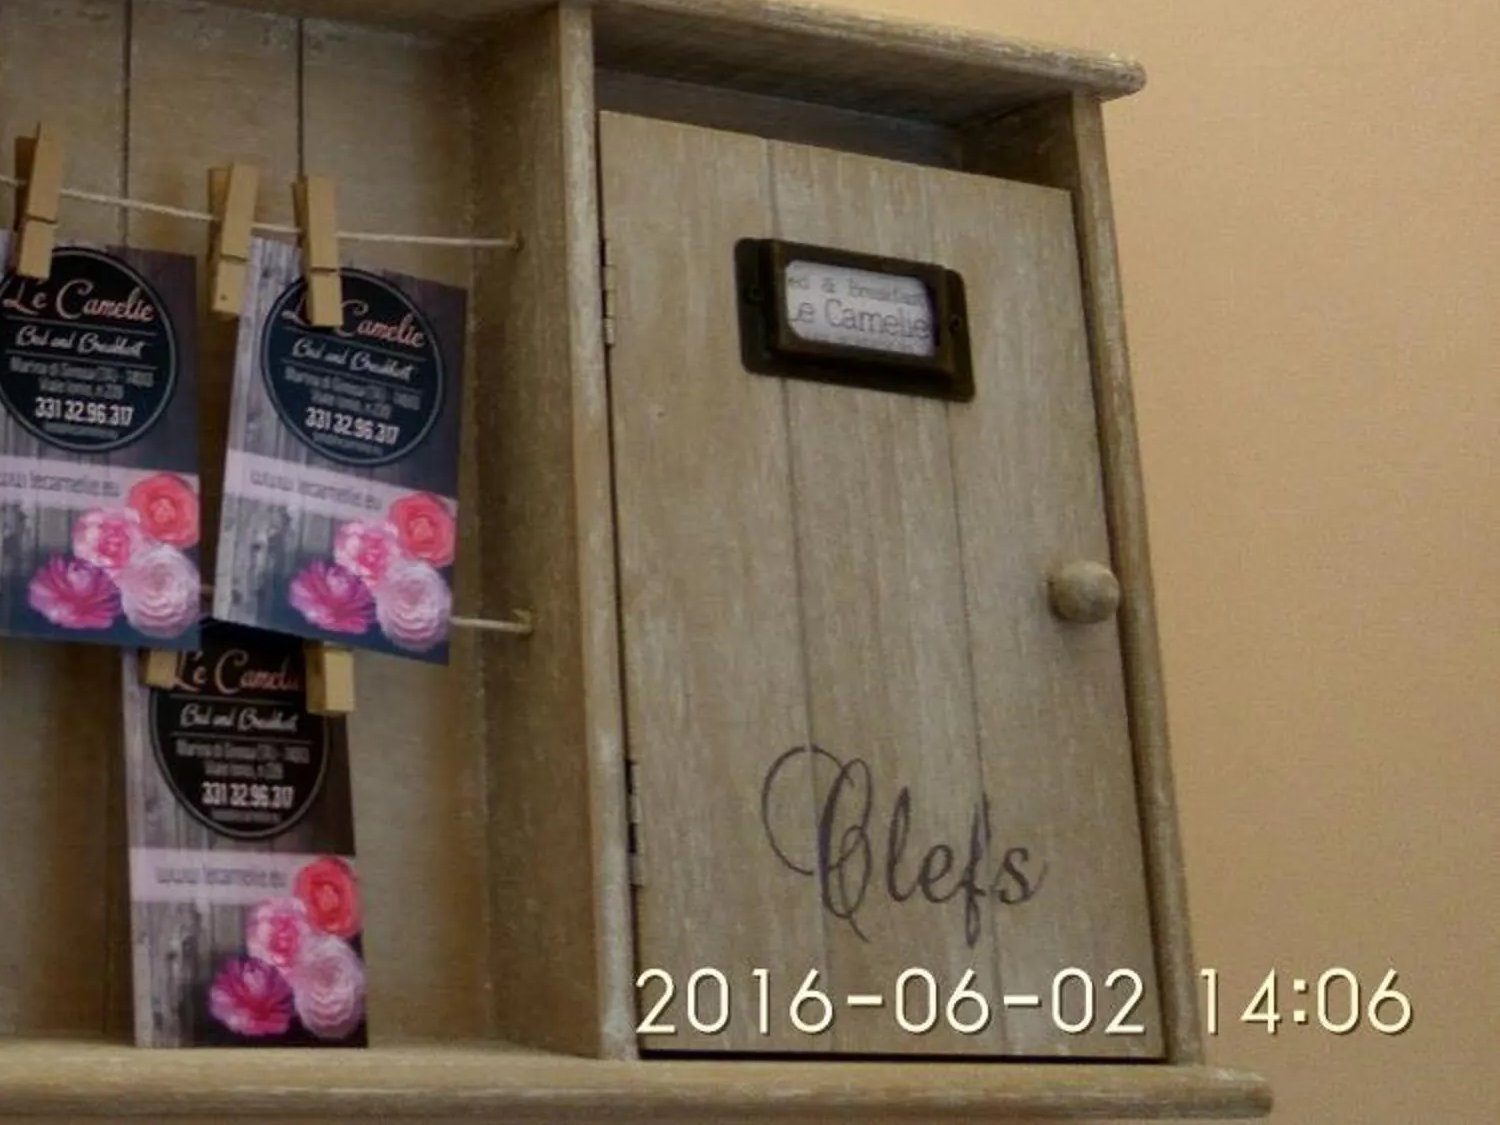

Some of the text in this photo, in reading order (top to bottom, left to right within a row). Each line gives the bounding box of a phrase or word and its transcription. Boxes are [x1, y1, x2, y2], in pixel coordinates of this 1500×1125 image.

[55, 278, 156, 322] Camelie
[824, 297, 930, 340] Camelie
[33, 396, 62, 420] 331
[761, 743, 1047, 949] Clefs
